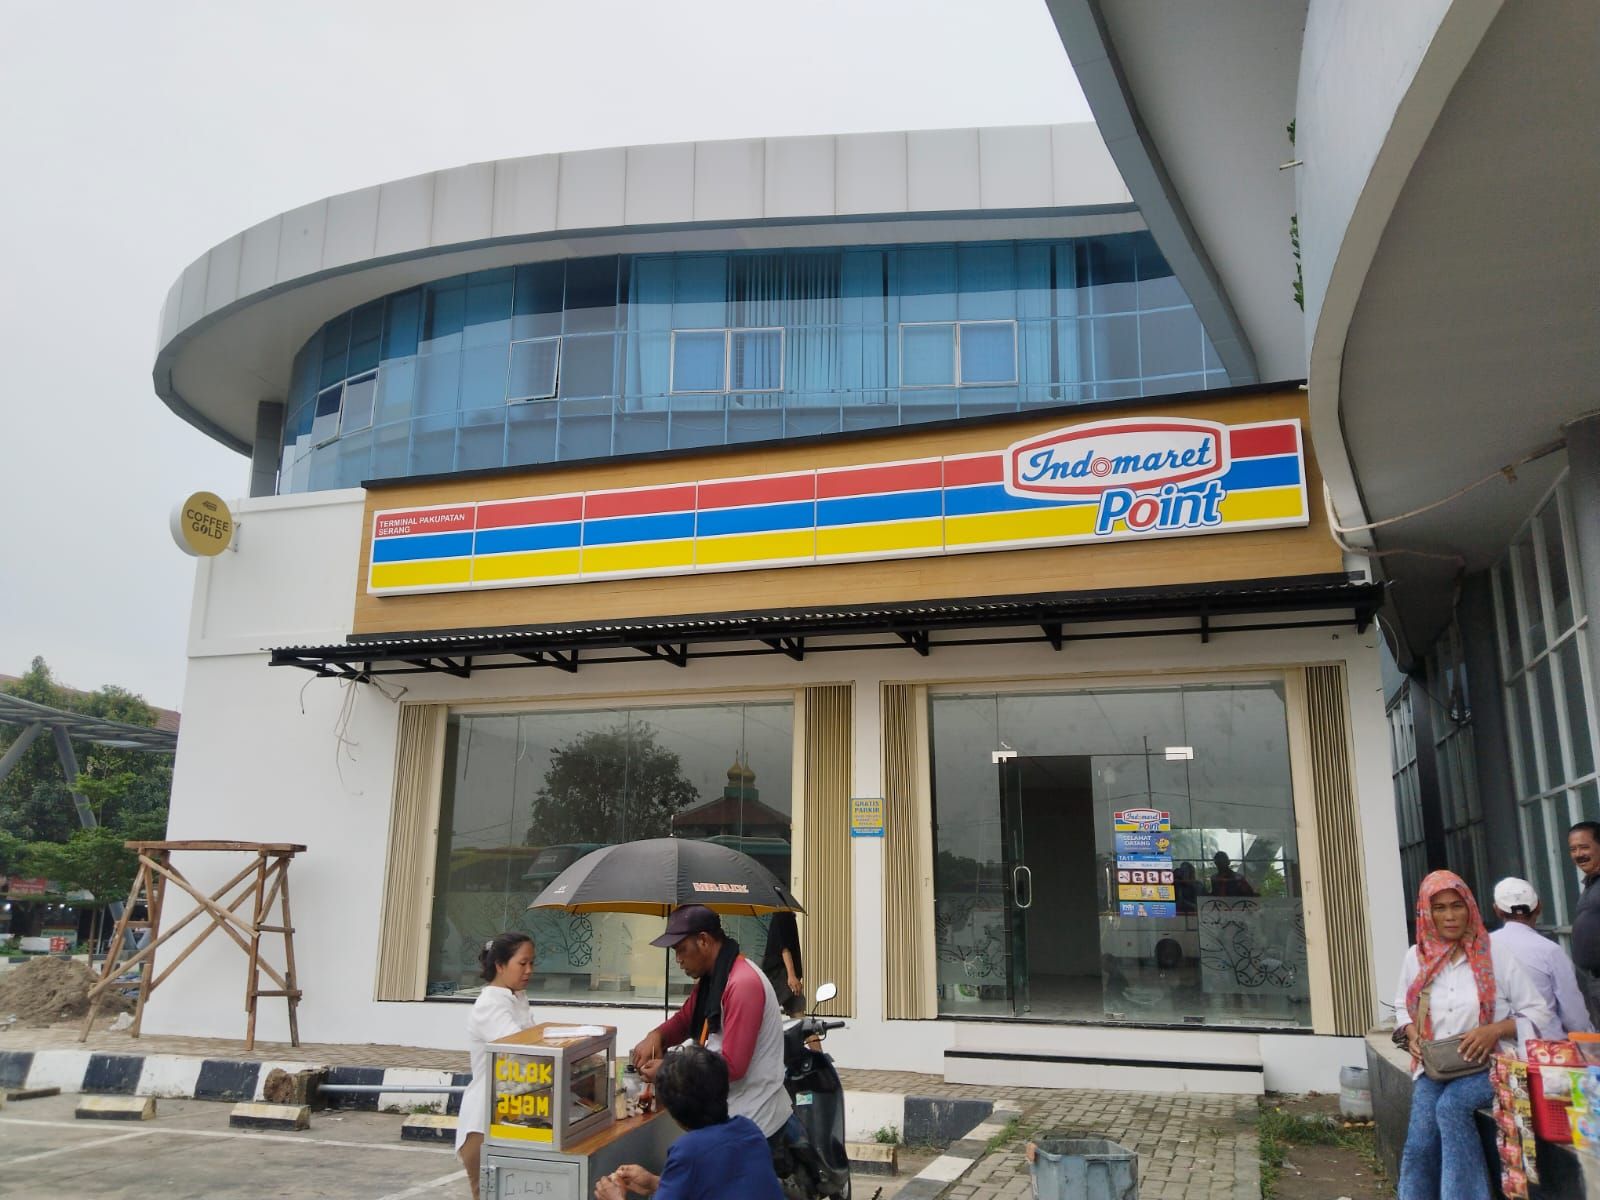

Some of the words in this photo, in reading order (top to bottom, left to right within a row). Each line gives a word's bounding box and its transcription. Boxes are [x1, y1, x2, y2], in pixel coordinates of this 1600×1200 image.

[1022, 437, 1212, 482] Indomaret
[1096, 480, 1226, 535] Point
[186, 509, 229, 532] COFFEE
[191, 521, 223, 540] GOLD
[378, 526, 411, 536] SERANG
[379, 518, 418, 528] TERMINAL
[419, 513, 466, 524] PAKUPATAN
[495, 1059, 552, 1084] CILOK
